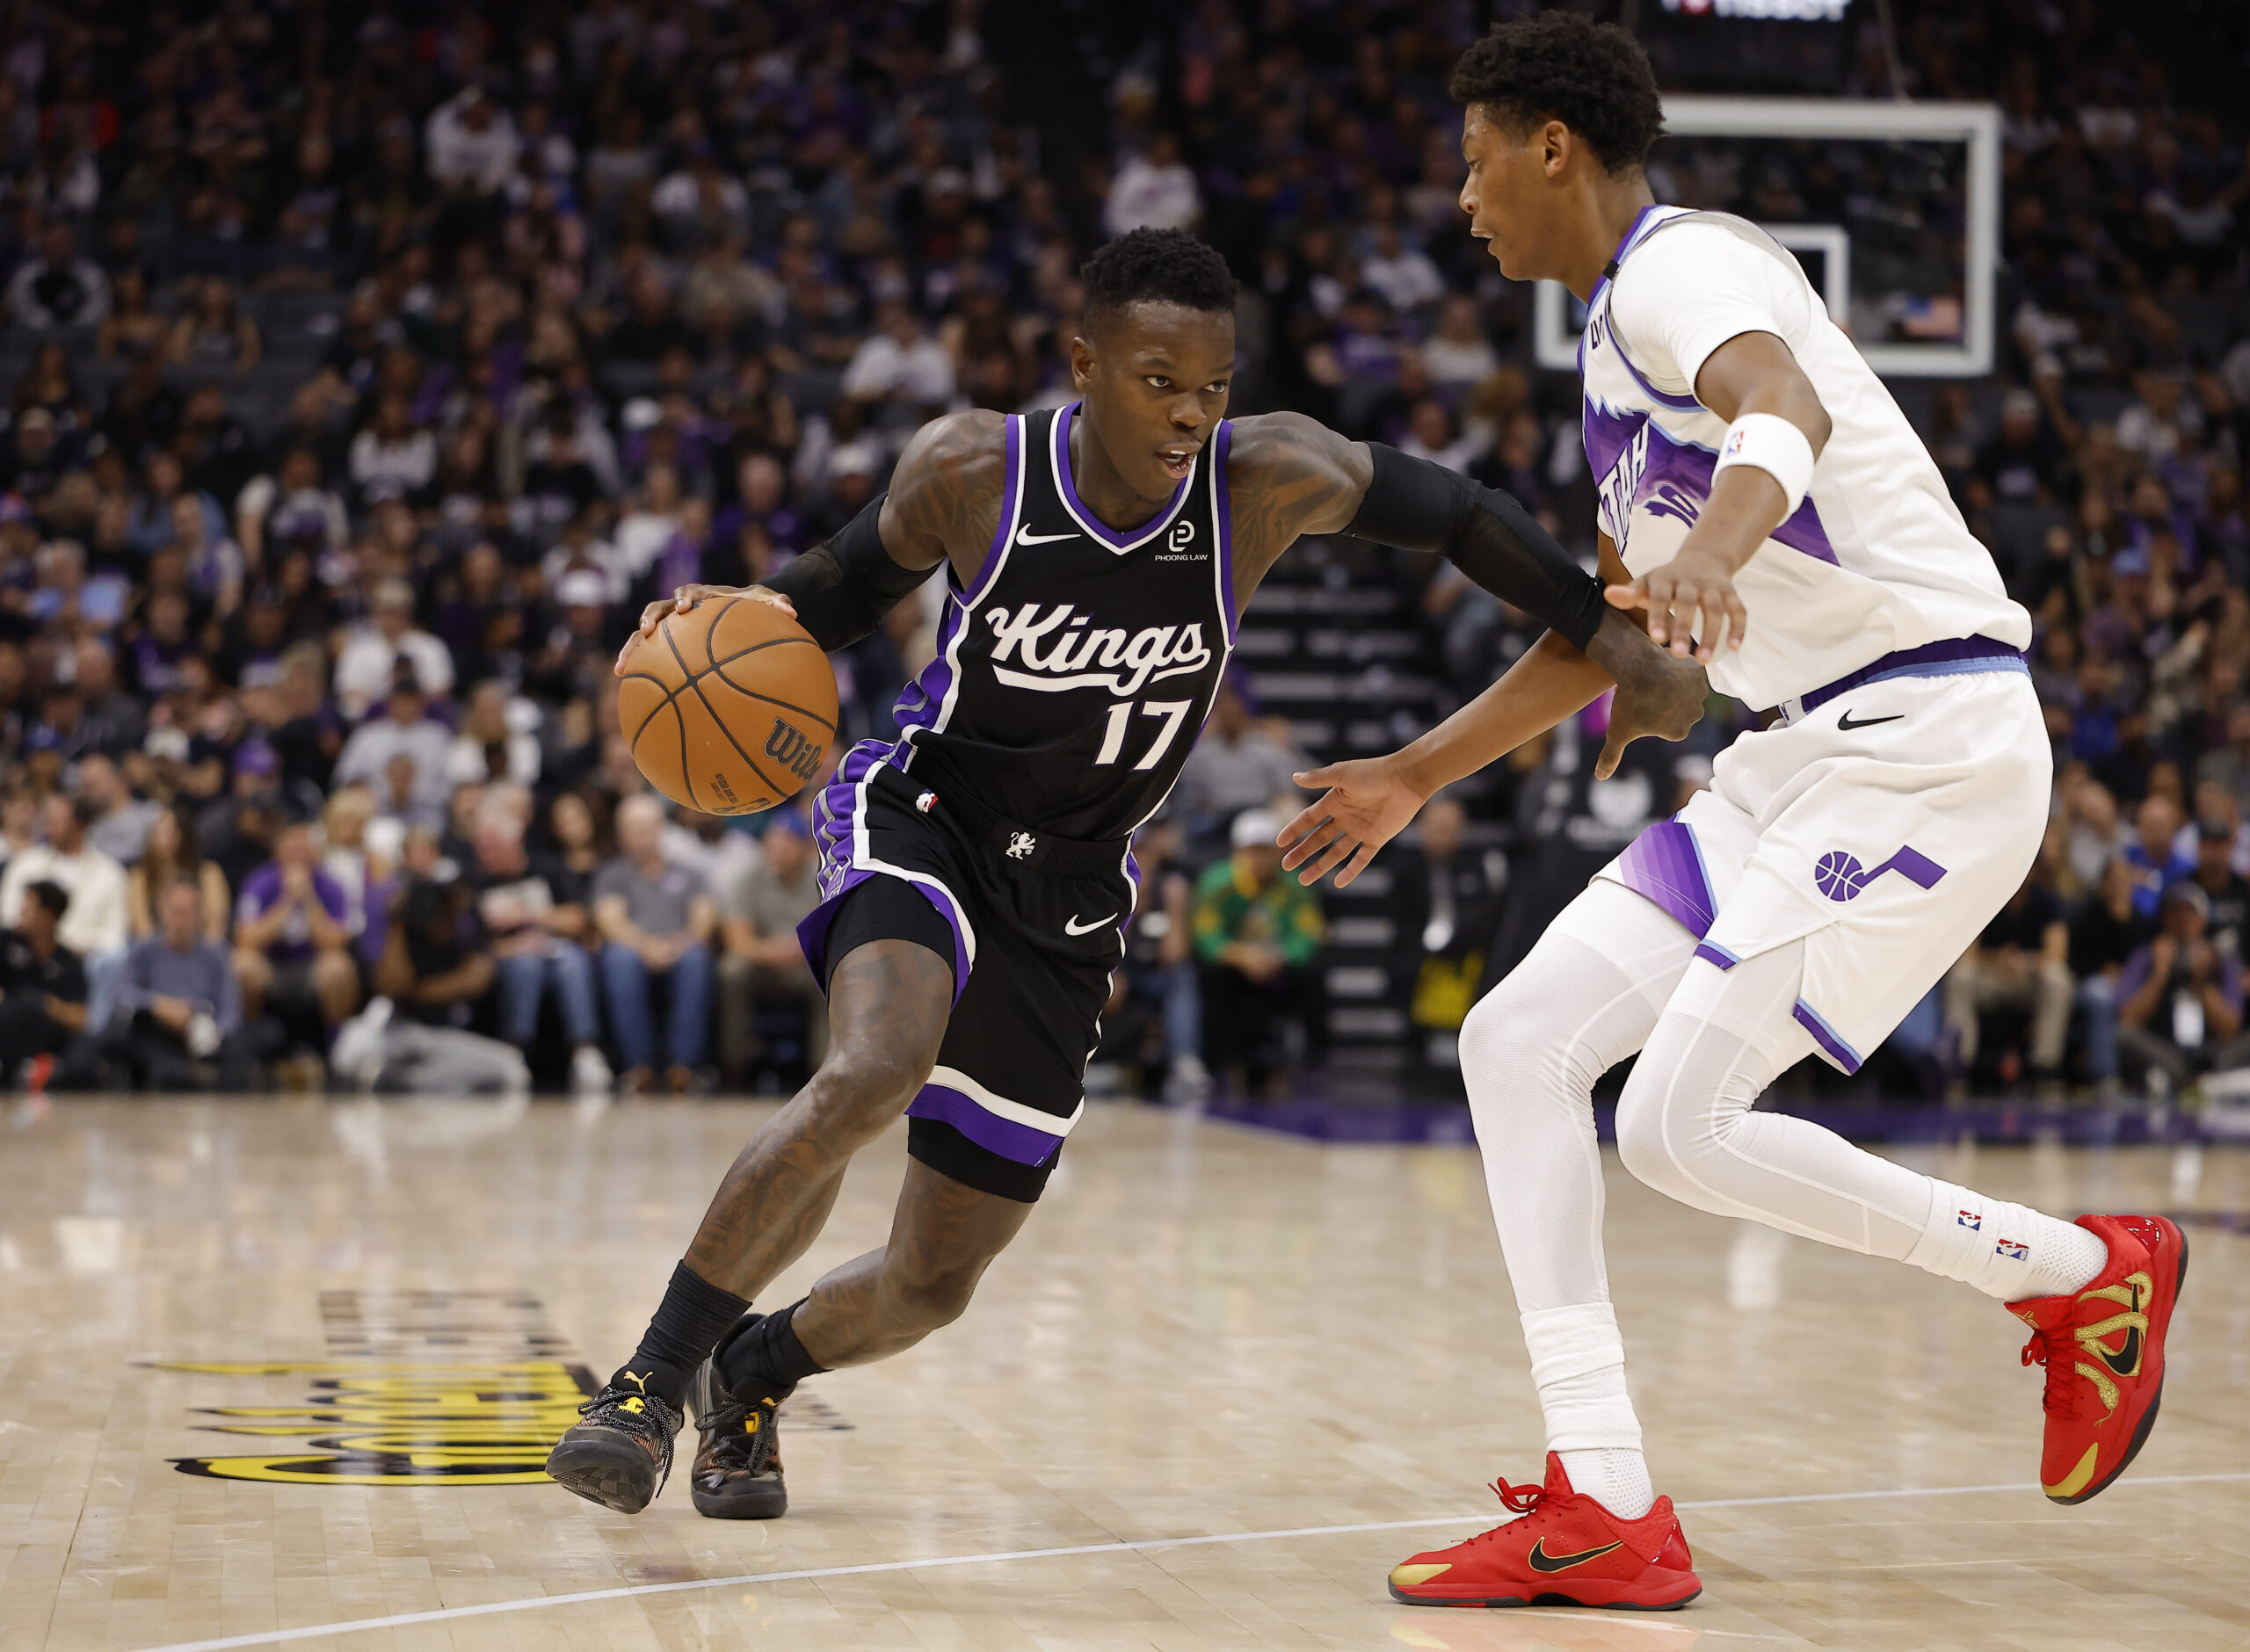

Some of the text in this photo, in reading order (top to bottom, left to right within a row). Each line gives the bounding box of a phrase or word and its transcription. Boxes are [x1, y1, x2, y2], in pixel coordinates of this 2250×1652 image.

[1598, 412, 1650, 558] TAH
[984, 603, 1211, 697] Kings
[1092, 698, 1194, 771] 17
